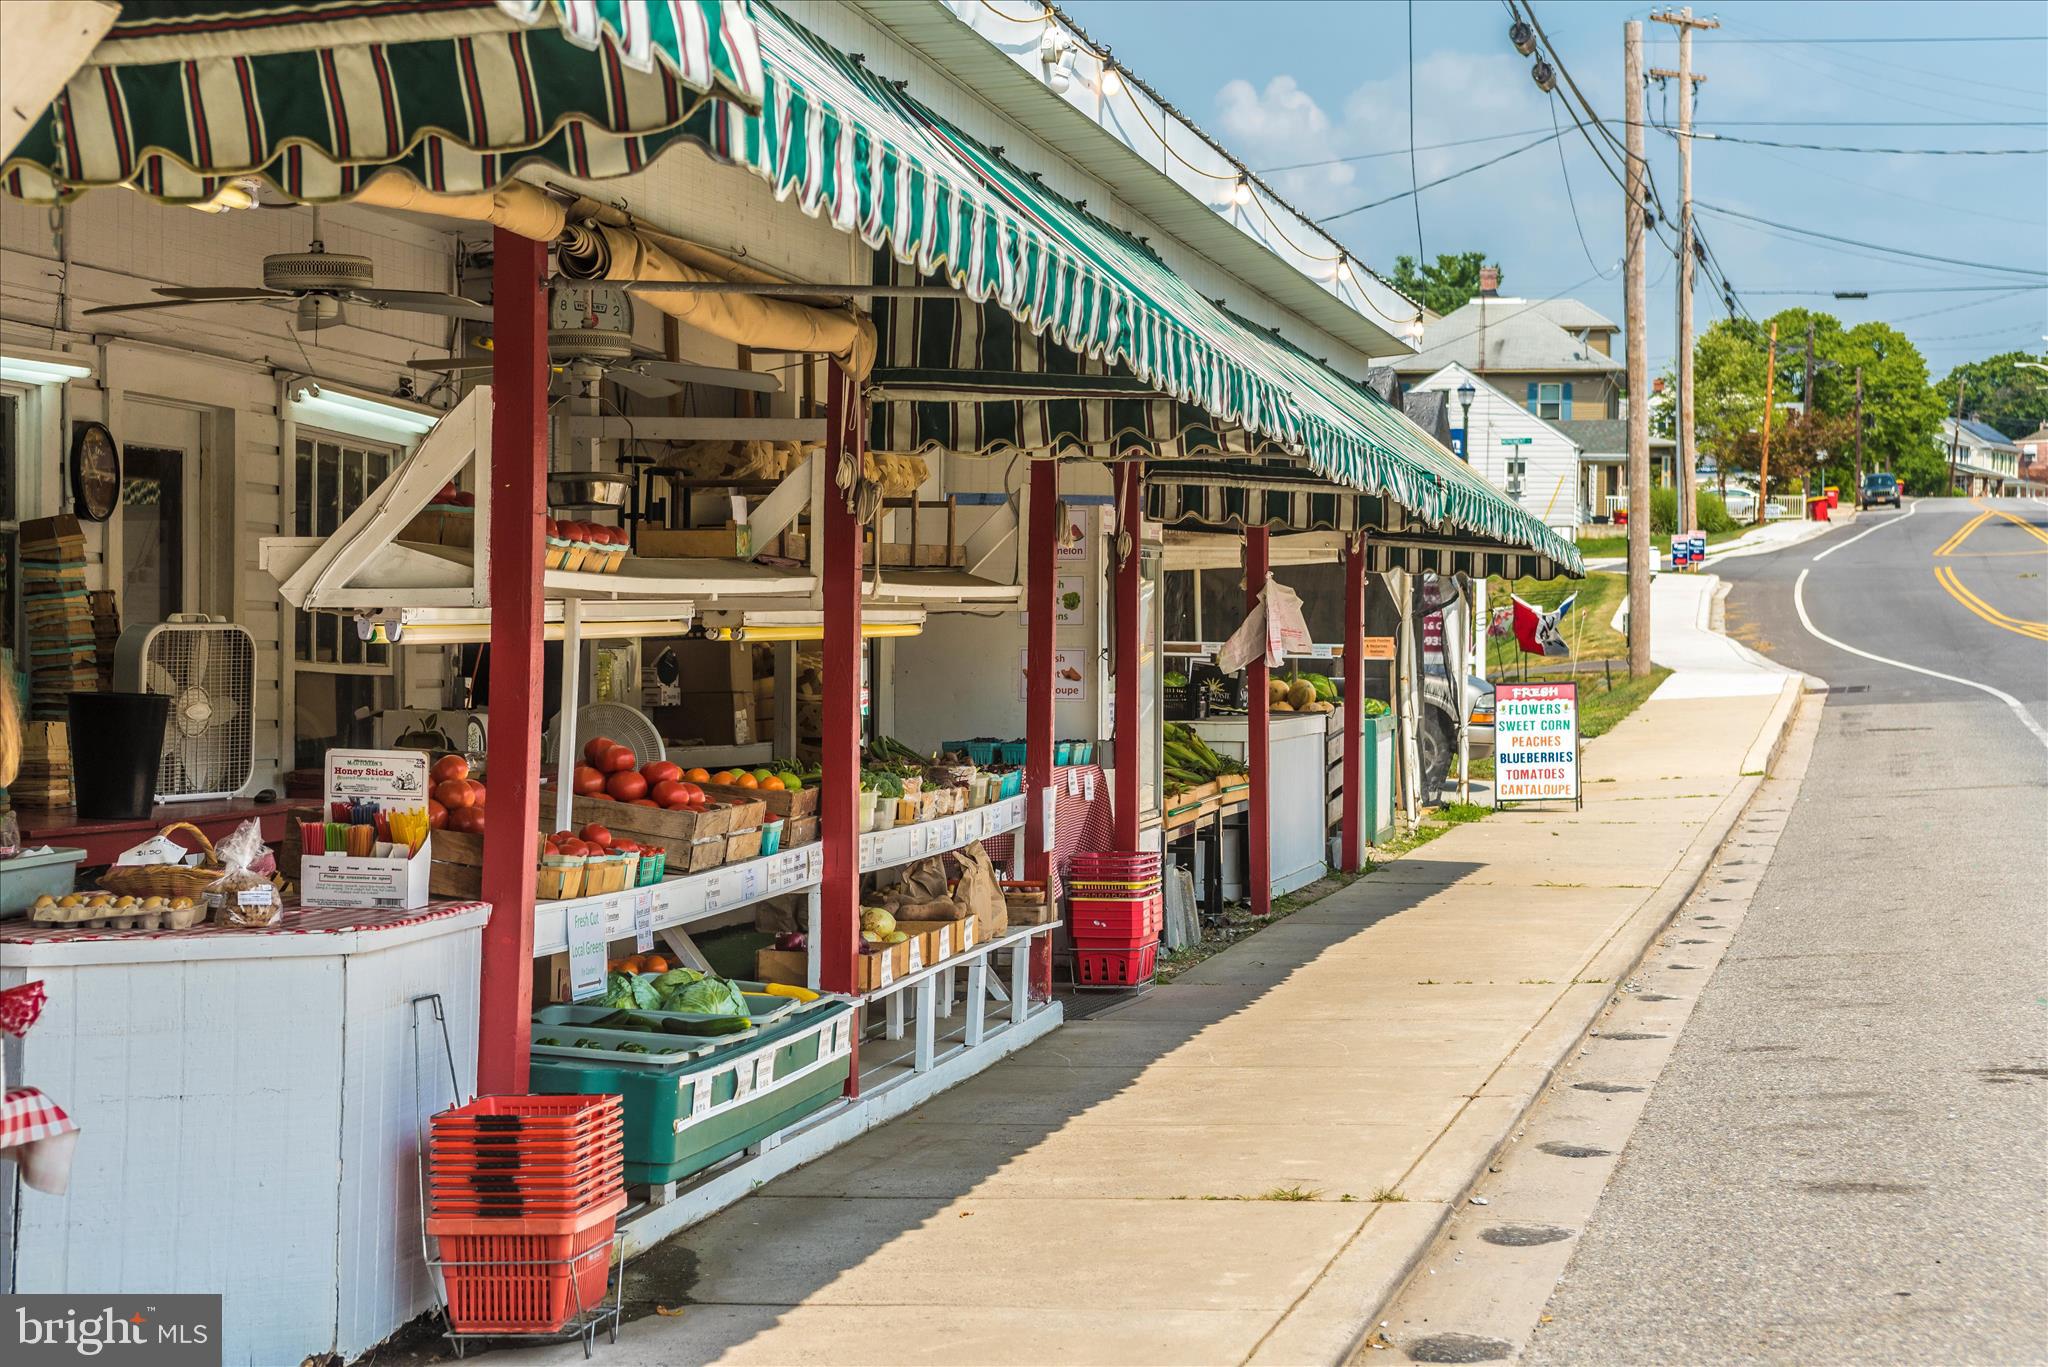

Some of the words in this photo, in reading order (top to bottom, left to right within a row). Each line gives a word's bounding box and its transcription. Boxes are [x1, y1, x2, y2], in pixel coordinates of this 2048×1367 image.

[560, 300, 567, 311] 8
[613, 306, 620, 316] 2
[1512, 687, 1558, 698] FRESH
[1509, 704, 1561, 715] FLOWERS
[1499, 720, 1535, 732] SWEET
[1541, 720, 1570, 731] CORN
[1512, 736, 1561, 747] PEACHES
[1500, 752, 1572, 764] BLUEBERRIES
[334, 767, 364, 776] Honey
[366, 768, 394, 776] Sticks
[1506, 768, 1564, 780] TOMATOES
[1501, 784, 1571, 795] CANTALOUPE
[575, 912, 589, 928] Fresh
[590, 912, 600, 926] Cut
[572, 943, 585, 958] Local
[586, 941, 604, 955] Greens
